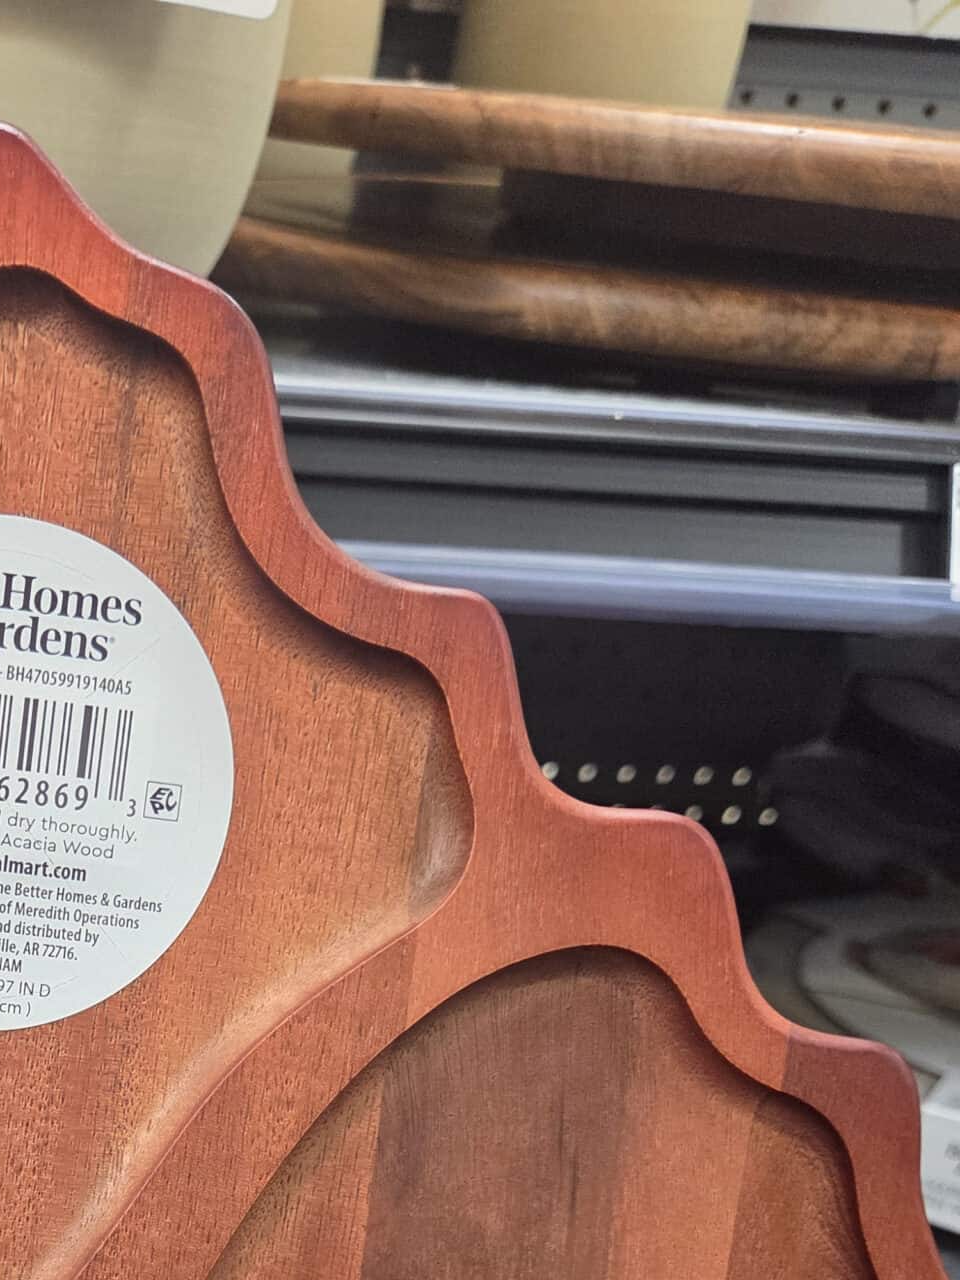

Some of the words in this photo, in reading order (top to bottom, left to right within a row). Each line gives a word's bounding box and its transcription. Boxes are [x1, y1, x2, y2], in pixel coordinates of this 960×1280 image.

[0, 572, 142, 626] Homes
[6, 664, 132, 695] BH47059919140A5
[126, 798, 137, 817] 3
[7, 811, 36, 832] dry
[41, 815, 137, 844] thoroughly.
[0, 832, 57, 852] Acacia
[63, 839, 115, 859] Wood
[14, 882, 54, 900] Better
[56, 887, 98, 905] Homes
[100, 892, 110, 906] &
[113, 894, 163, 912] Gardens
[0, 900, 13, 914] of
[14, 901, 70, 921] Meredith
[73, 908, 140, 929] Operations
[14, 920, 82, 941] distributed
[84, 928, 100, 947] by
[22, 941, 40, 956] AR
[42, 943, 78, 960] 72716.
[18, 980, 35, 995] IN
[39, 983, 51, 997] D
